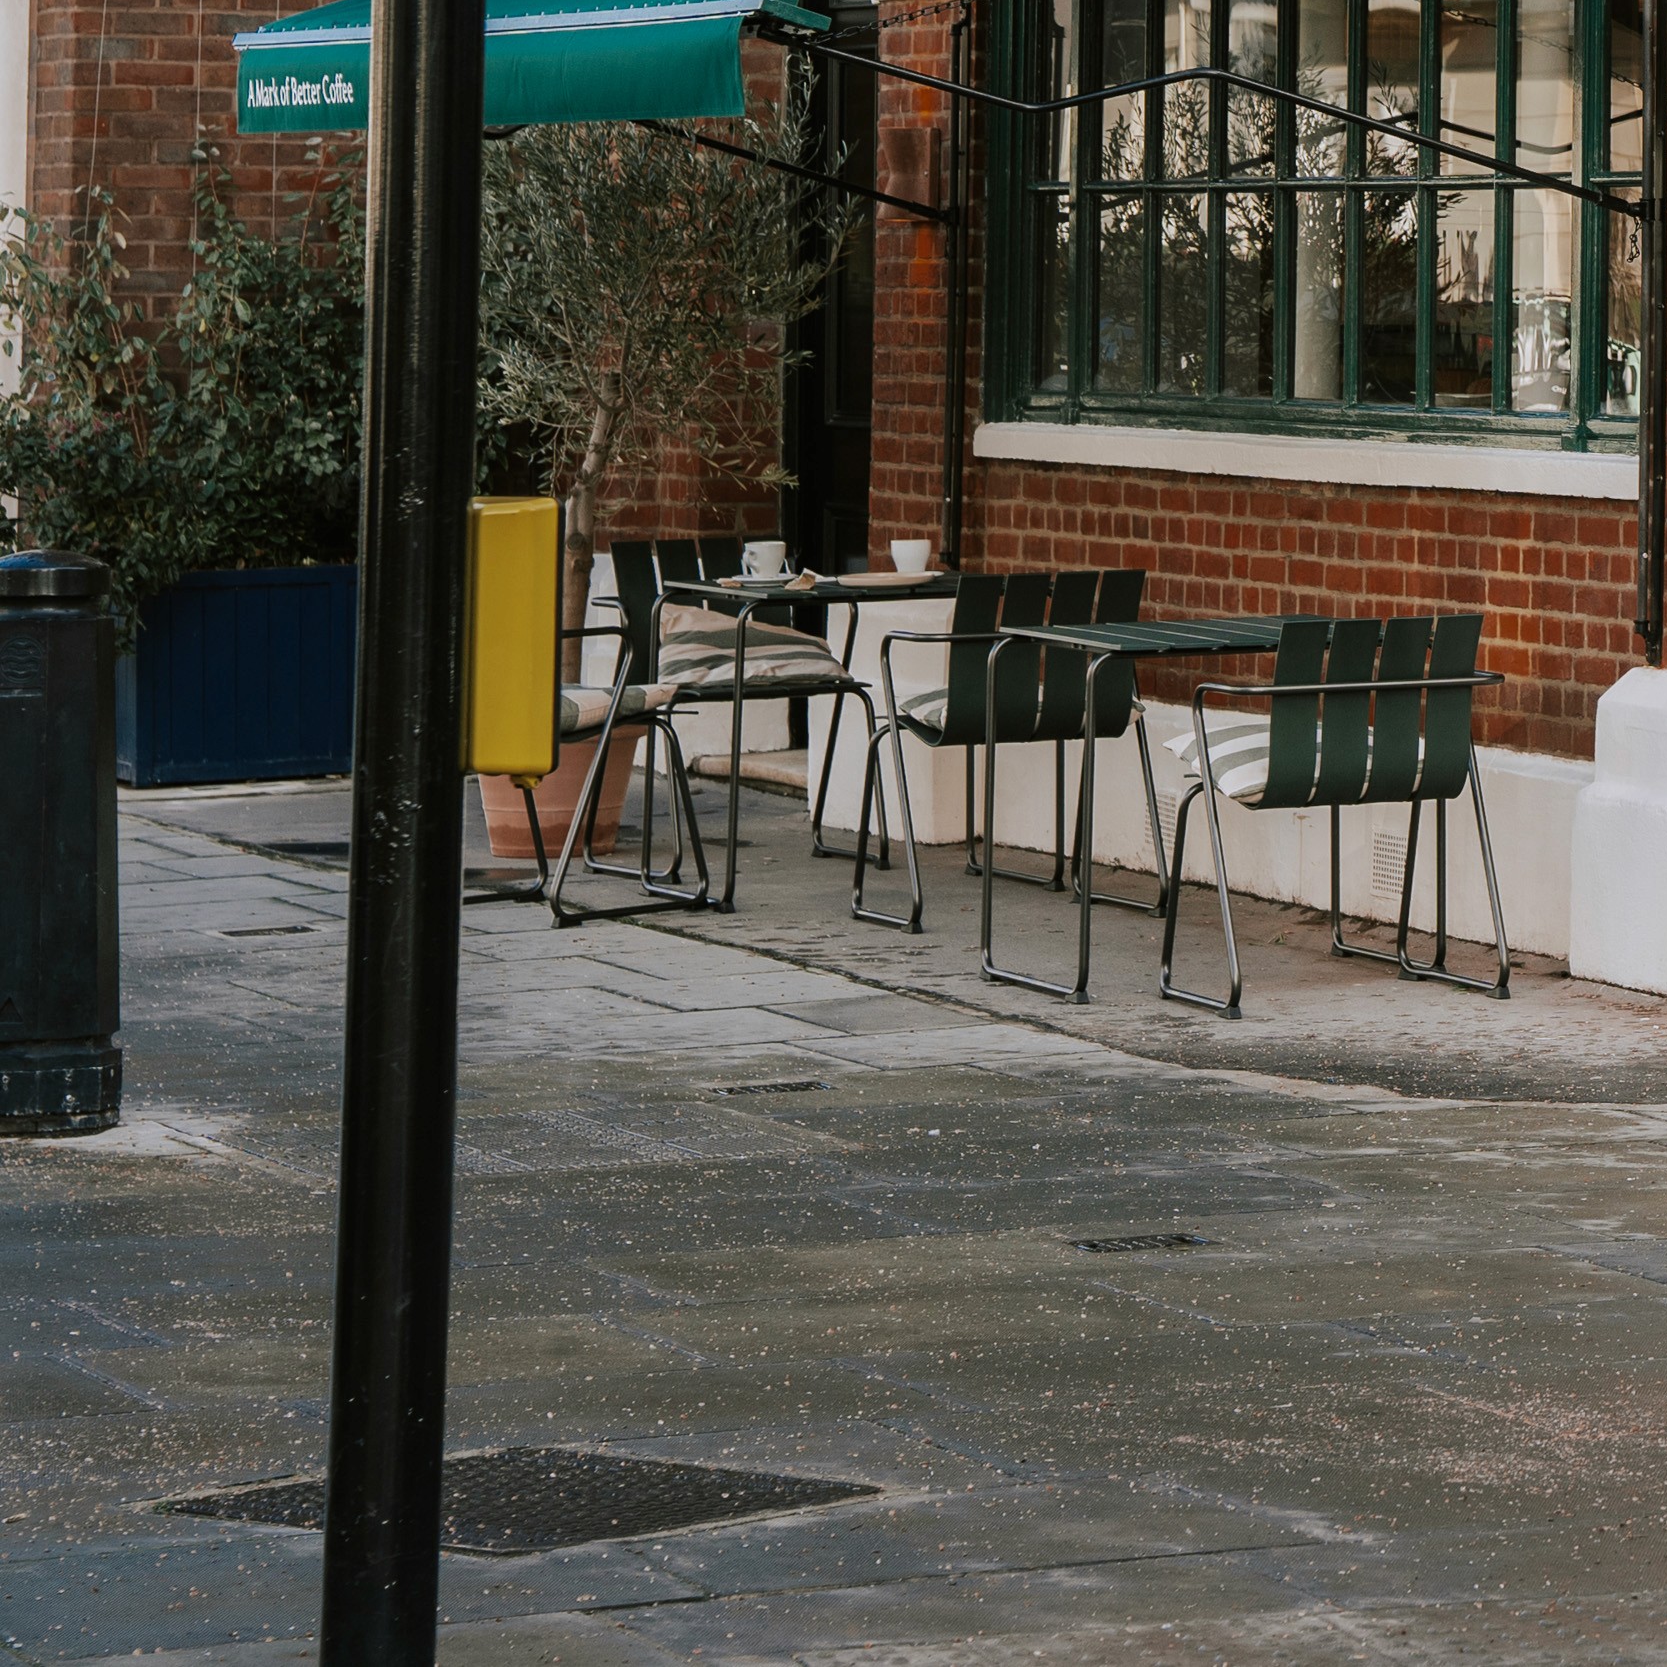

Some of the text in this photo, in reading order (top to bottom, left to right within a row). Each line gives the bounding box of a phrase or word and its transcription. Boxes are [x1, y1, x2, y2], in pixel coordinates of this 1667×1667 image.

[247, 73, 354, 108] A Mark of Better Coffee
